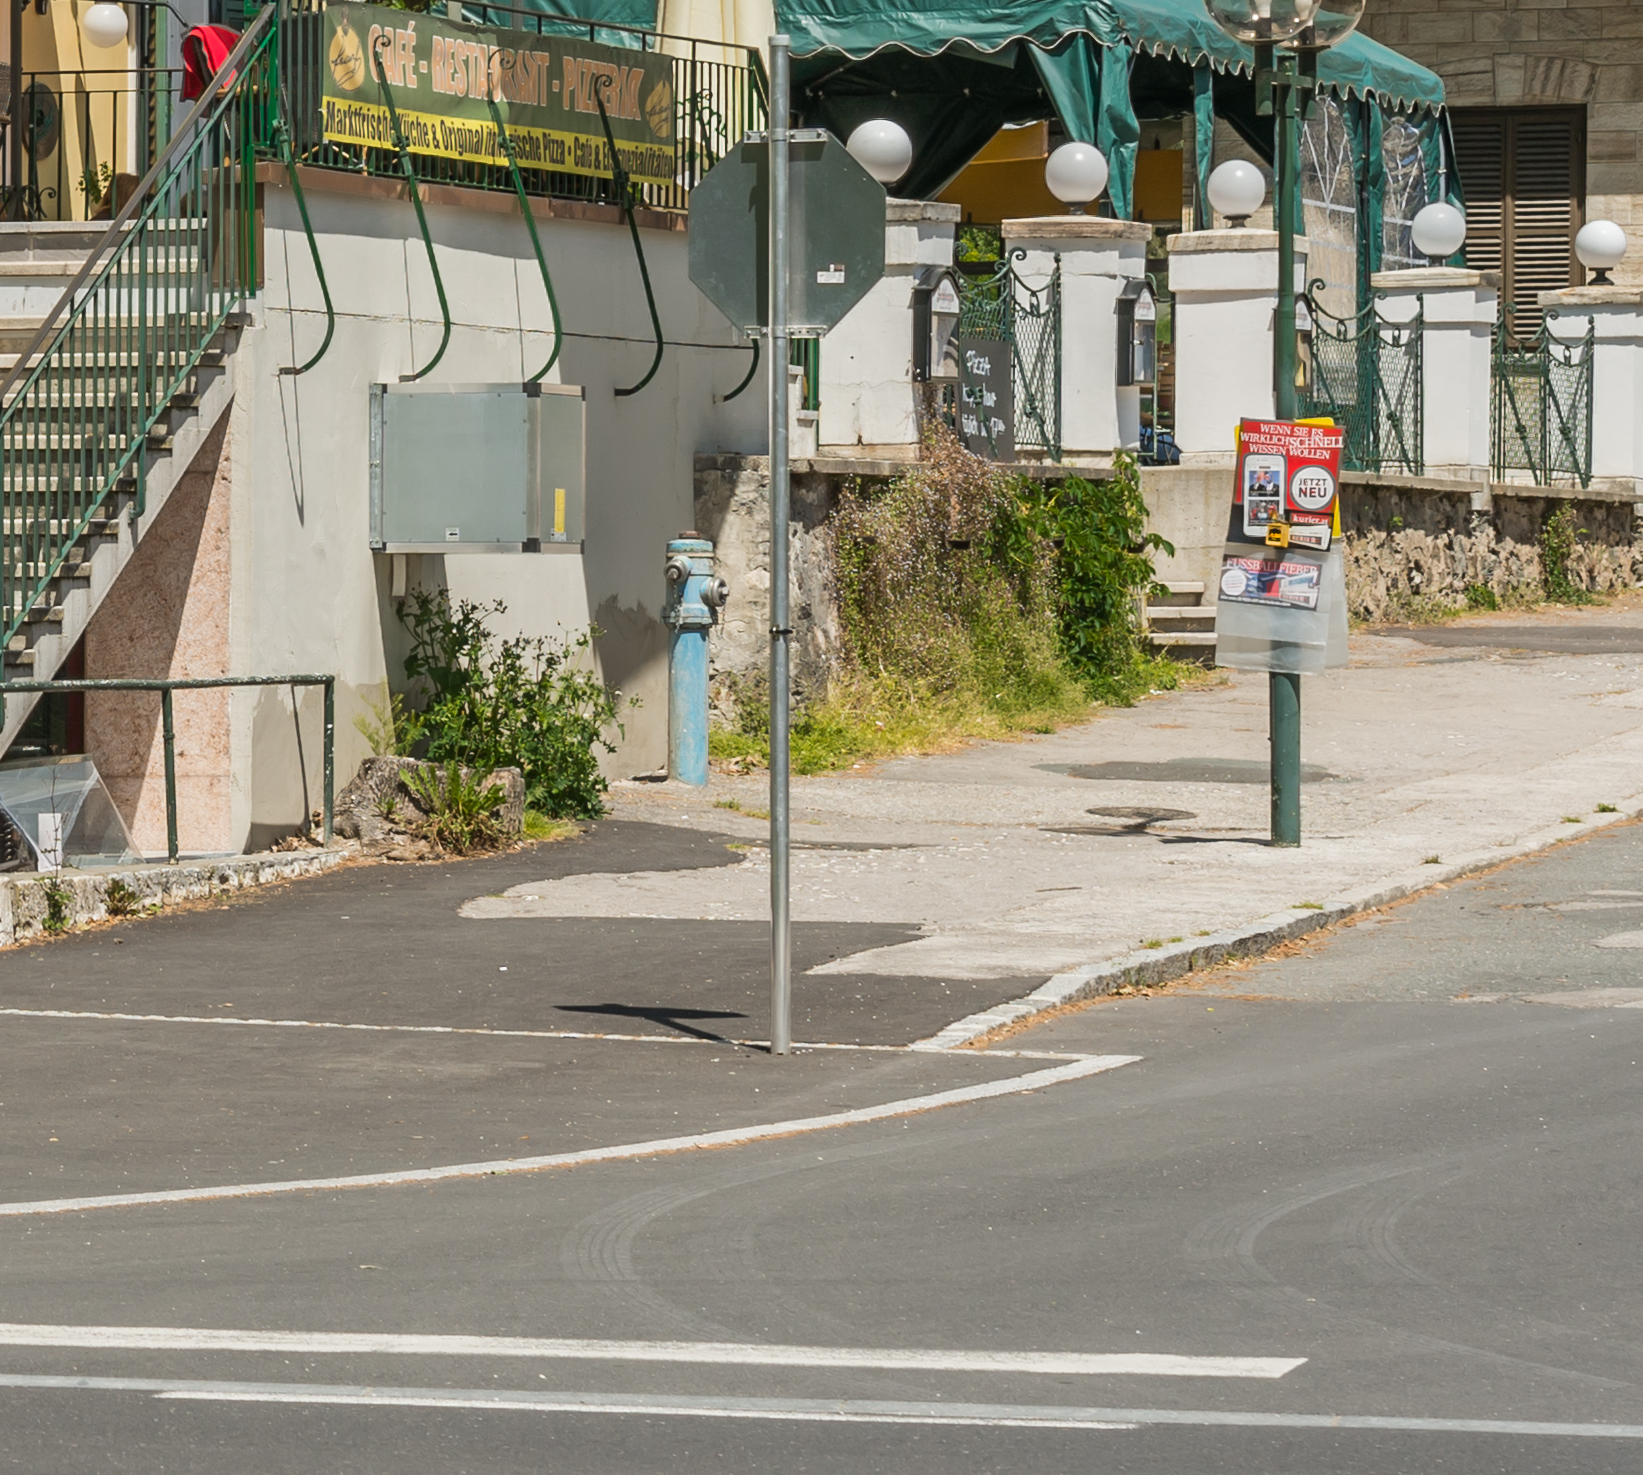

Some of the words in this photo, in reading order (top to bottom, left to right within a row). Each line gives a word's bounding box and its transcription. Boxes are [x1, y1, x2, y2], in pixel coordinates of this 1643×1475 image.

[432, 34, 549, 107] RESTAURANT
[563, 55, 645, 121] PIZZERIA
[432, 123, 441, 149] &
[440, 119, 484, 156] Original
[542, 131, 566, 165] Pizza
[1260, 423, 1292, 435] WENN
[1293, 426, 1309, 437] SIE
[1240, 432, 1290, 445] WIRKLICH
[1249, 443, 1287, 456] WISSEN
[1288, 445, 1331, 460] WOLLEN
[1299, 478, 1327, 486] JETZT
[1298, 487, 1327, 498] NEU
